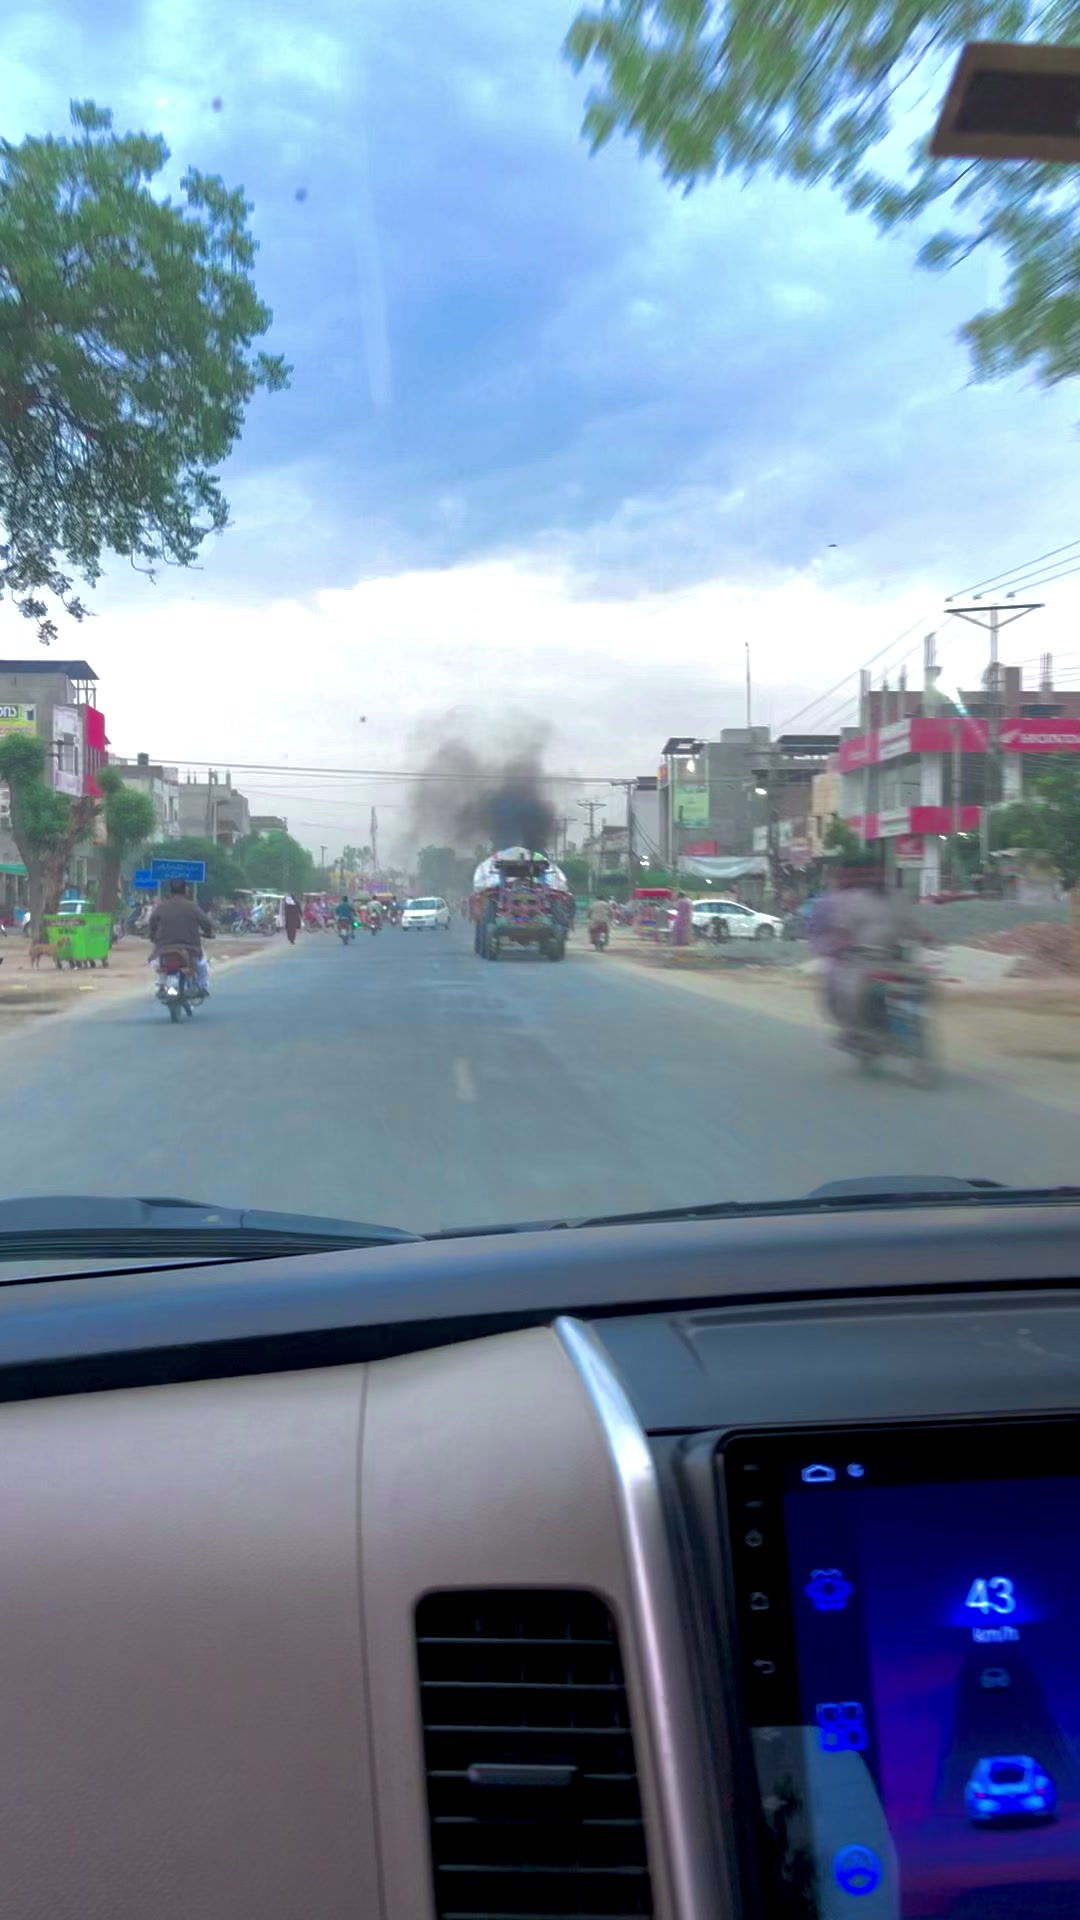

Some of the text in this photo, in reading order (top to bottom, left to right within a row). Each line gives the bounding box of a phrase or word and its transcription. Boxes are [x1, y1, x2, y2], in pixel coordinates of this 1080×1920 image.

[1021, 733, 1080, 744] HOND
[964, 1575, 1016, 1614] 43
[972, 1625, 1021, 1643] km/h
